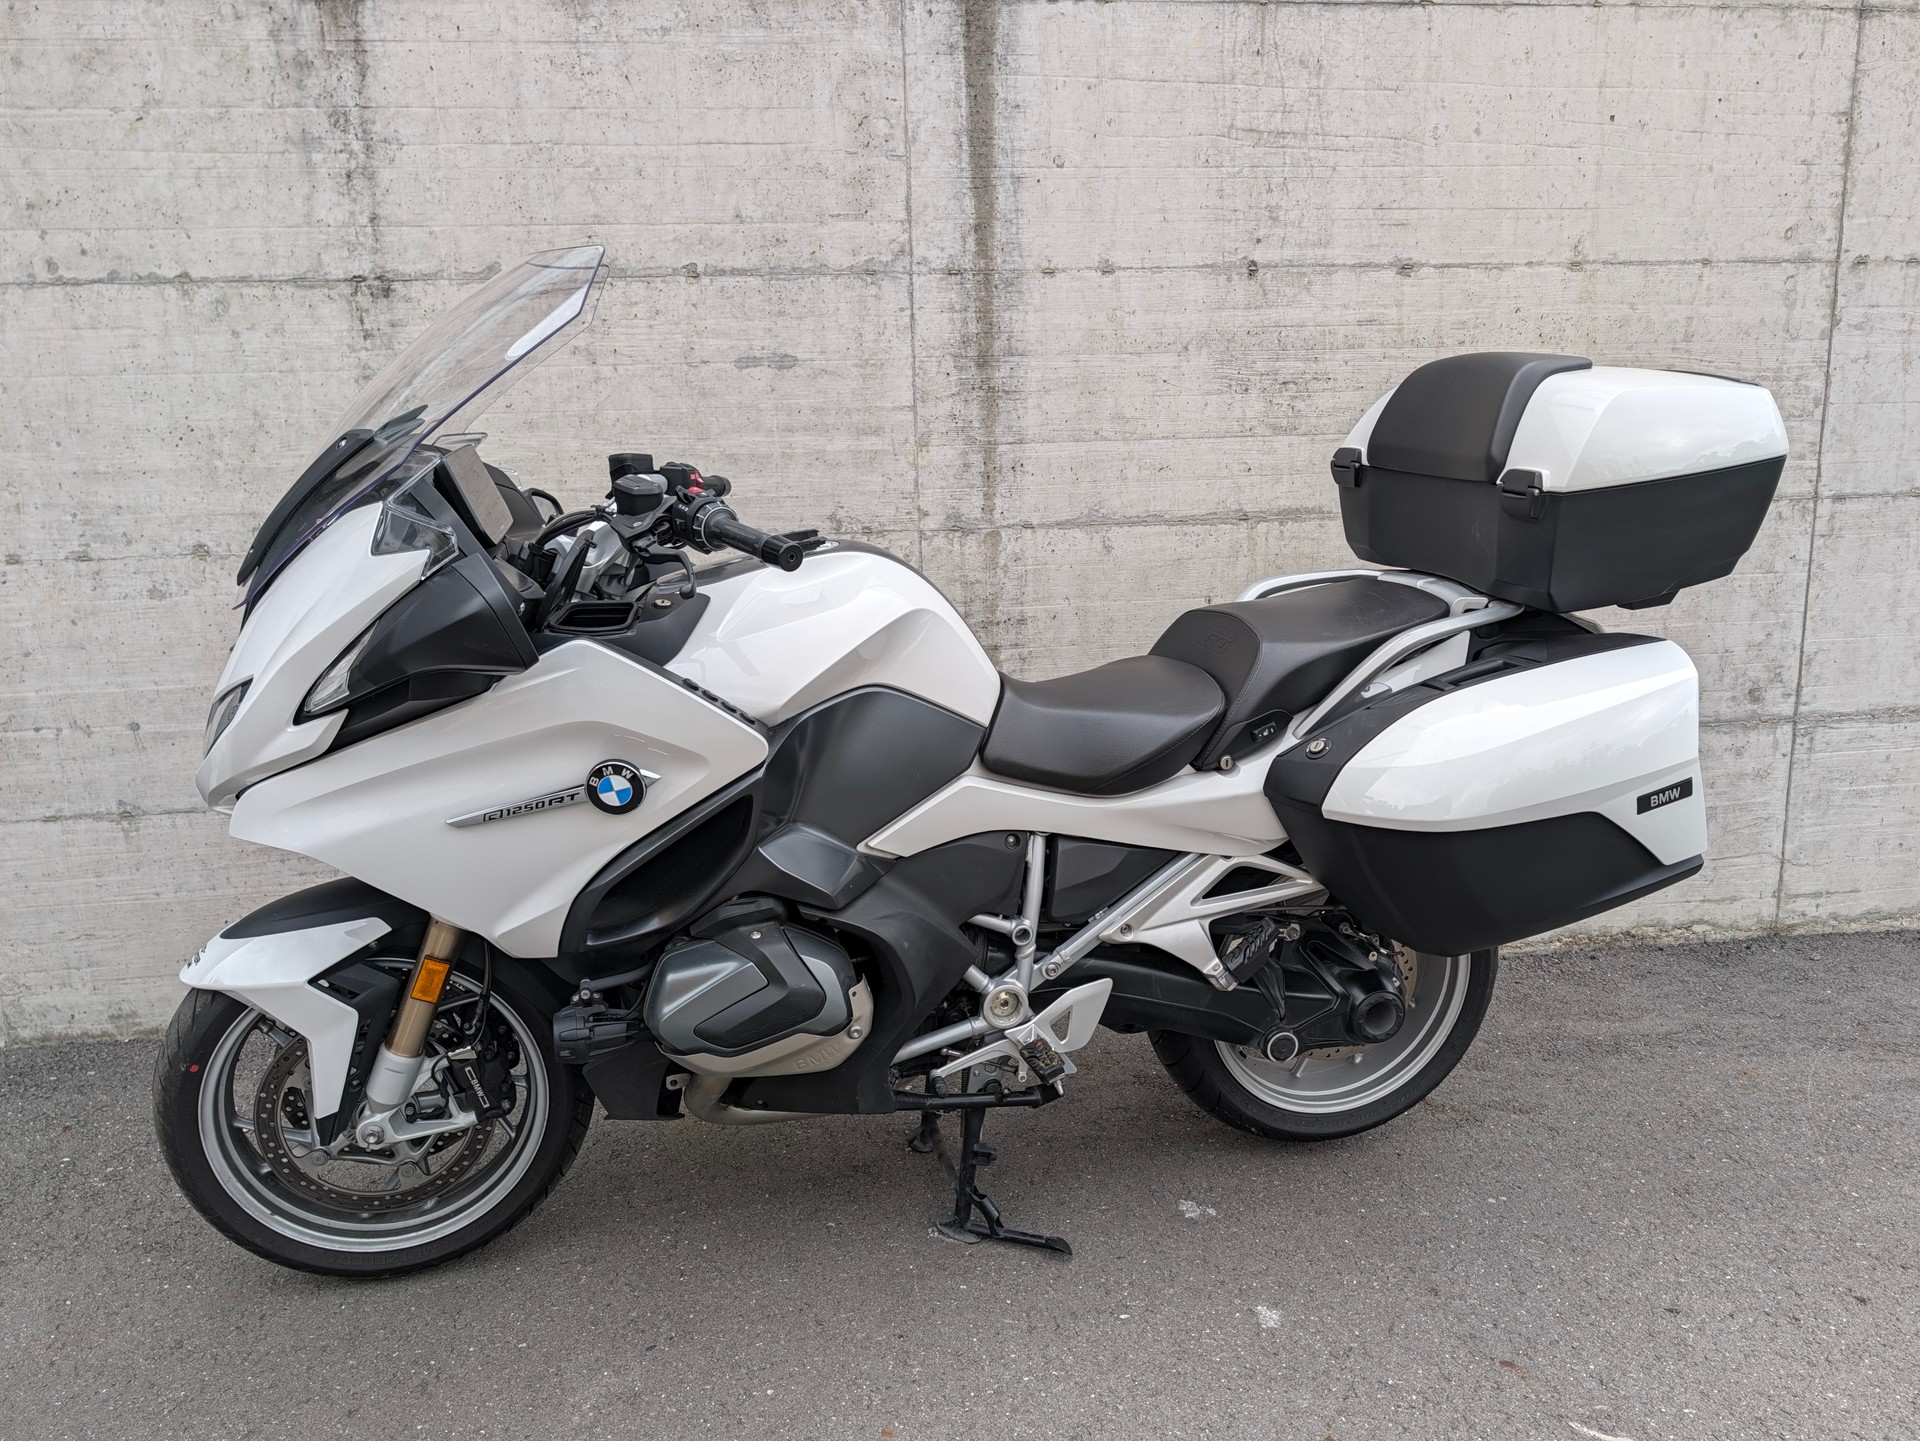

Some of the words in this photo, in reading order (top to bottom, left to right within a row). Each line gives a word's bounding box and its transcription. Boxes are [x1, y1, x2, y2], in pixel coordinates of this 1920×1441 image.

[589, 766, 634, 787] BMW
[1650, 787, 1681, 807] BMW
[794, 1041, 841, 1072] BMW
[471, 1079, 485, 1097] BMW
